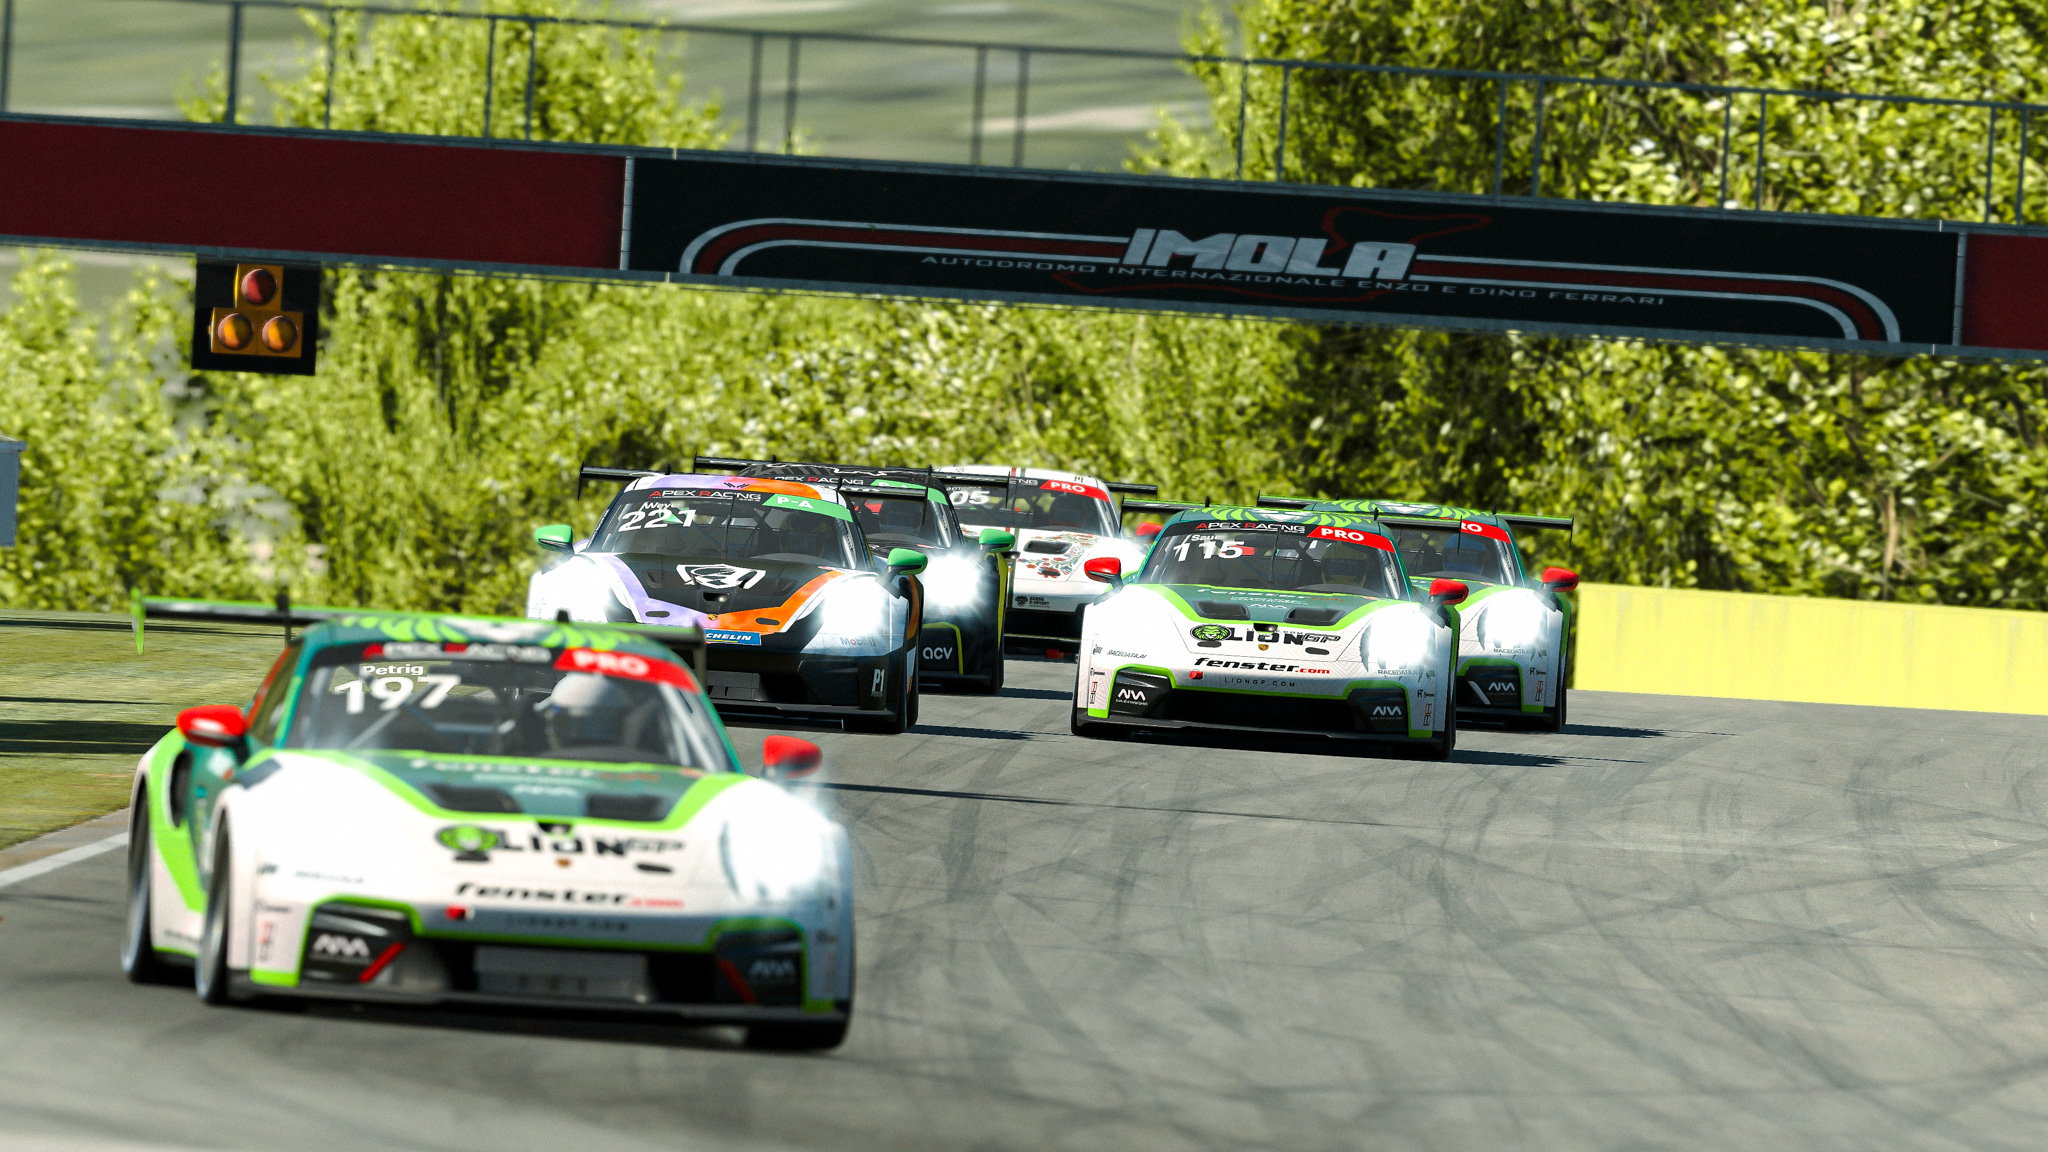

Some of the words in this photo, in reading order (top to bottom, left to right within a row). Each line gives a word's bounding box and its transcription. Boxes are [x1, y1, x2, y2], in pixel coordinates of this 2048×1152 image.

[1122, 228, 1416, 280] IMOLA
[921, 255, 1096, 273] AUTODROMO
[1108, 266, 1345, 287] INTERNAZIONALE
[1357, 281, 1430, 292] ENZO
[1442, 286, 1456, 294] E
[1469, 287, 1536, 299] DINO
[1549, 292, 1665, 305] FERRARI
[807, 476, 864, 485] RACNG
[1050, 481, 1086, 493] PRO
[649, 490, 697, 498] APEX
[699, 490, 761, 500] RACNG
[950, 490, 990, 506] 05
[777, 496, 814, 510] P-A
[618, 509, 697, 532] 221
[1244, 523, 1306, 533] RACNG
[1461, 523, 1482, 532] RO
[1321, 528, 1365, 541] PRO
[1173, 541, 1245, 562] 115
[705, 632, 752, 642] CHELIN
[923, 647, 953, 660] acv
[572, 648, 650, 676] PRO
[1194, 657, 1330, 675] fenster.com
[362, 664, 424, 677] Petrig
[871, 668, 885, 692] P1
[1224, 677, 1296, 687] LIONGP.COM
[334, 675, 462, 715] 197
